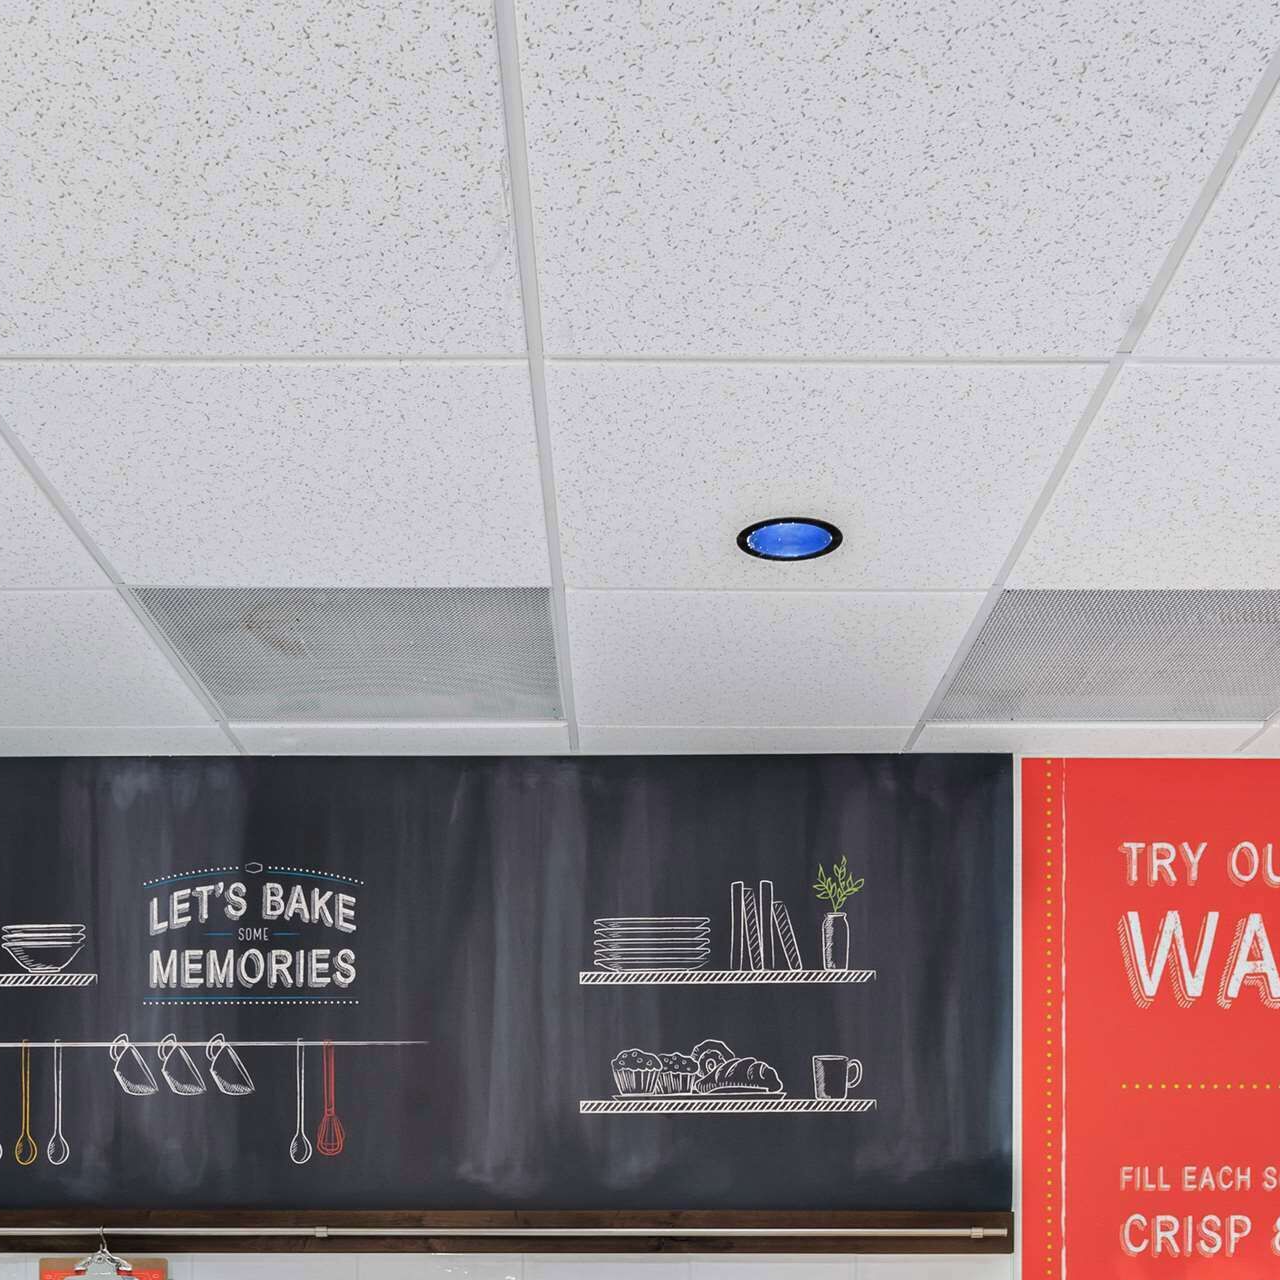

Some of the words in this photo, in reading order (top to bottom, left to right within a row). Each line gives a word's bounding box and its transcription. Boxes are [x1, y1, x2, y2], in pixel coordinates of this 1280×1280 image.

[1118, 841, 1207, 887] TRY
[149, 882, 248, 936] LET'S
[262, 882, 357, 933] BAKE
[238, 927, 269, 941] SOME
[149, 948, 356, 989] MEMORIES
[1120, 1166, 1171, 1192] FILL
[1183, 1166, 1250, 1192] EACH
[1120, 1214, 1252, 1258] CRISP
